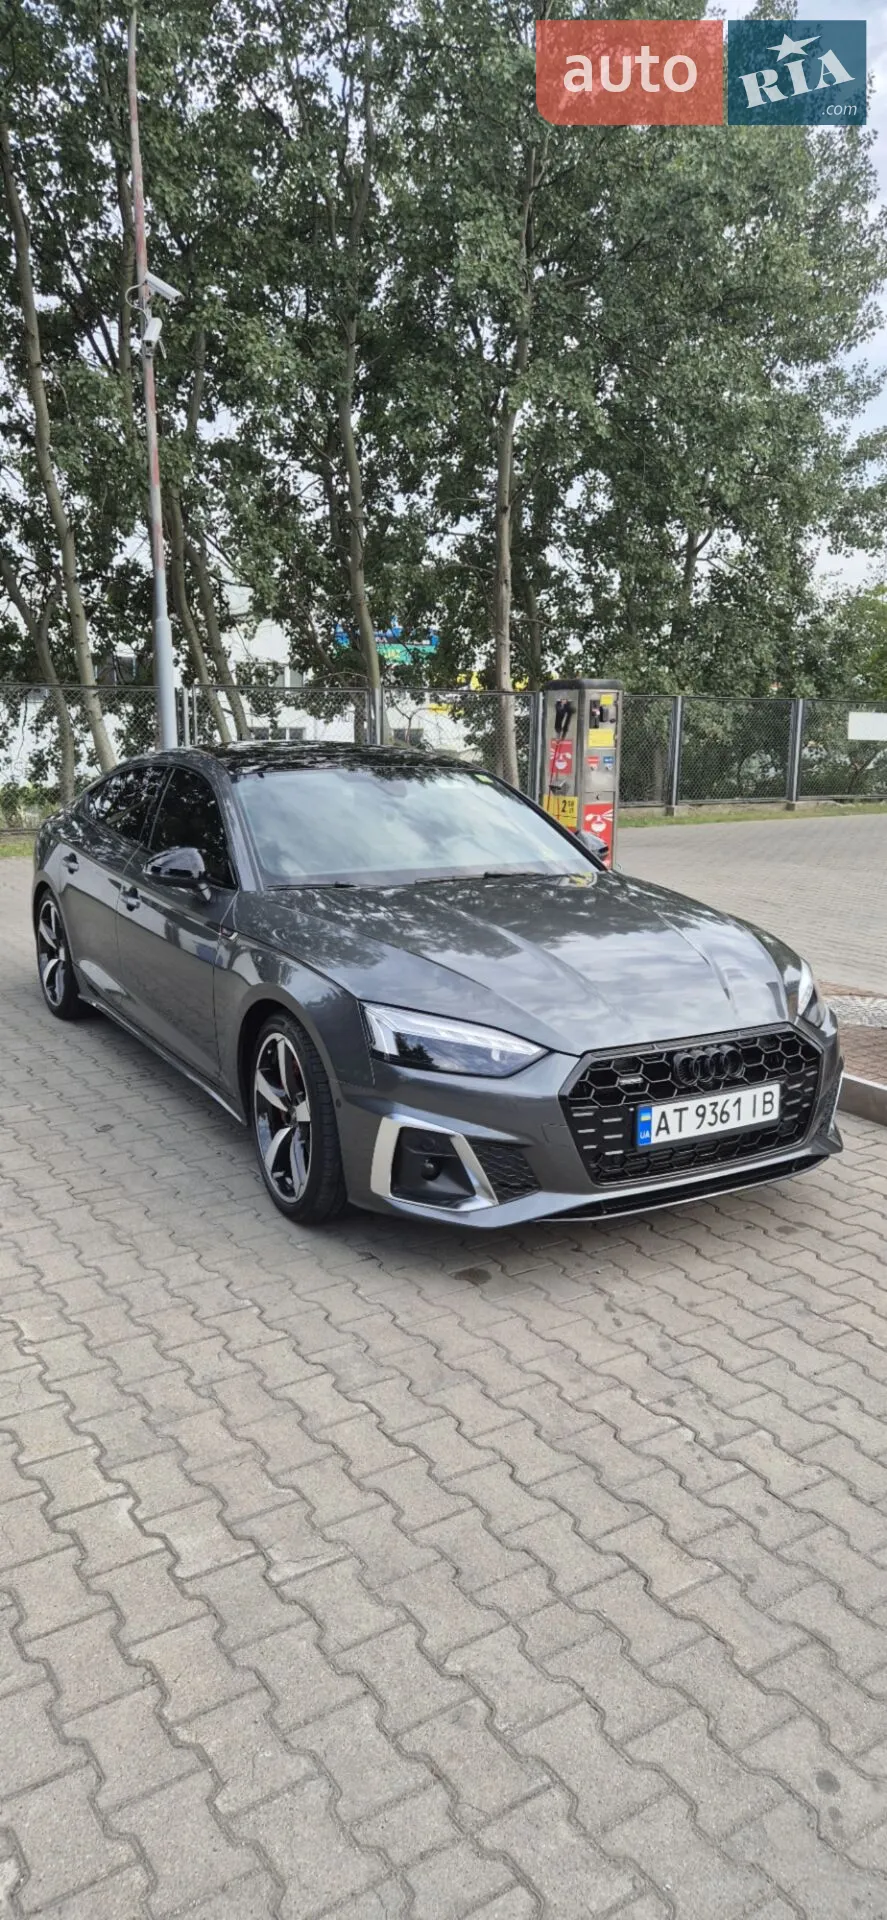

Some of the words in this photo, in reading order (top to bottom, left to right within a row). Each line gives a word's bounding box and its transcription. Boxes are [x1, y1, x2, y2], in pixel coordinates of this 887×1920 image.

[655, 1107, 689, 1137] AT
[695, 1097, 742, 1130] 9361
[752, 1090, 775, 1119] IB
[639, 1129, 651, 1140] UA
